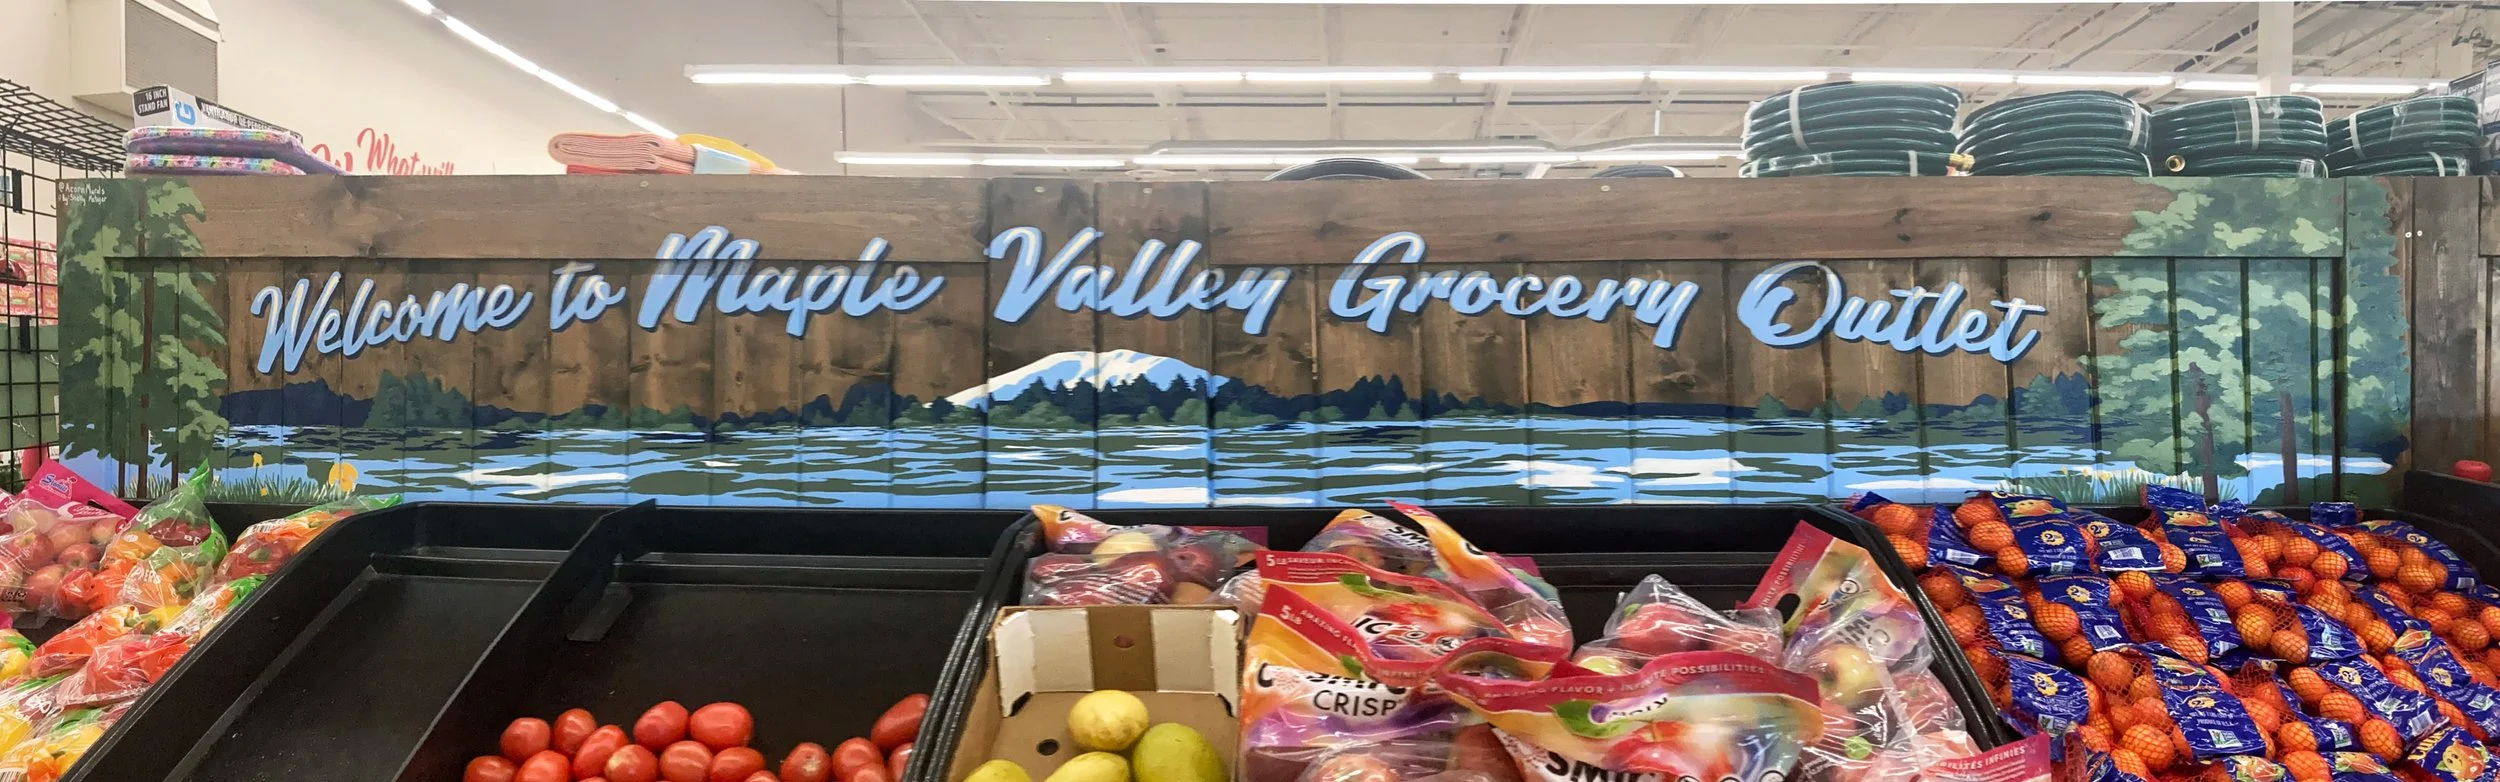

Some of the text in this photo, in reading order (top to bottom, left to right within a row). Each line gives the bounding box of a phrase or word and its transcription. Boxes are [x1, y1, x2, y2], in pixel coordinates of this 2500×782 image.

[138, 99, 169, 114] STAND FAN
[145, 88, 168, 101] 16 INCH
[357, 127, 420, 175] What
[250, 224, 2046, 374] Welcome to Maple Valley Grocery Outlet
[1313, 689, 1398, 717] CRISP
[1984, 745, 2026, 767] INFINIES
